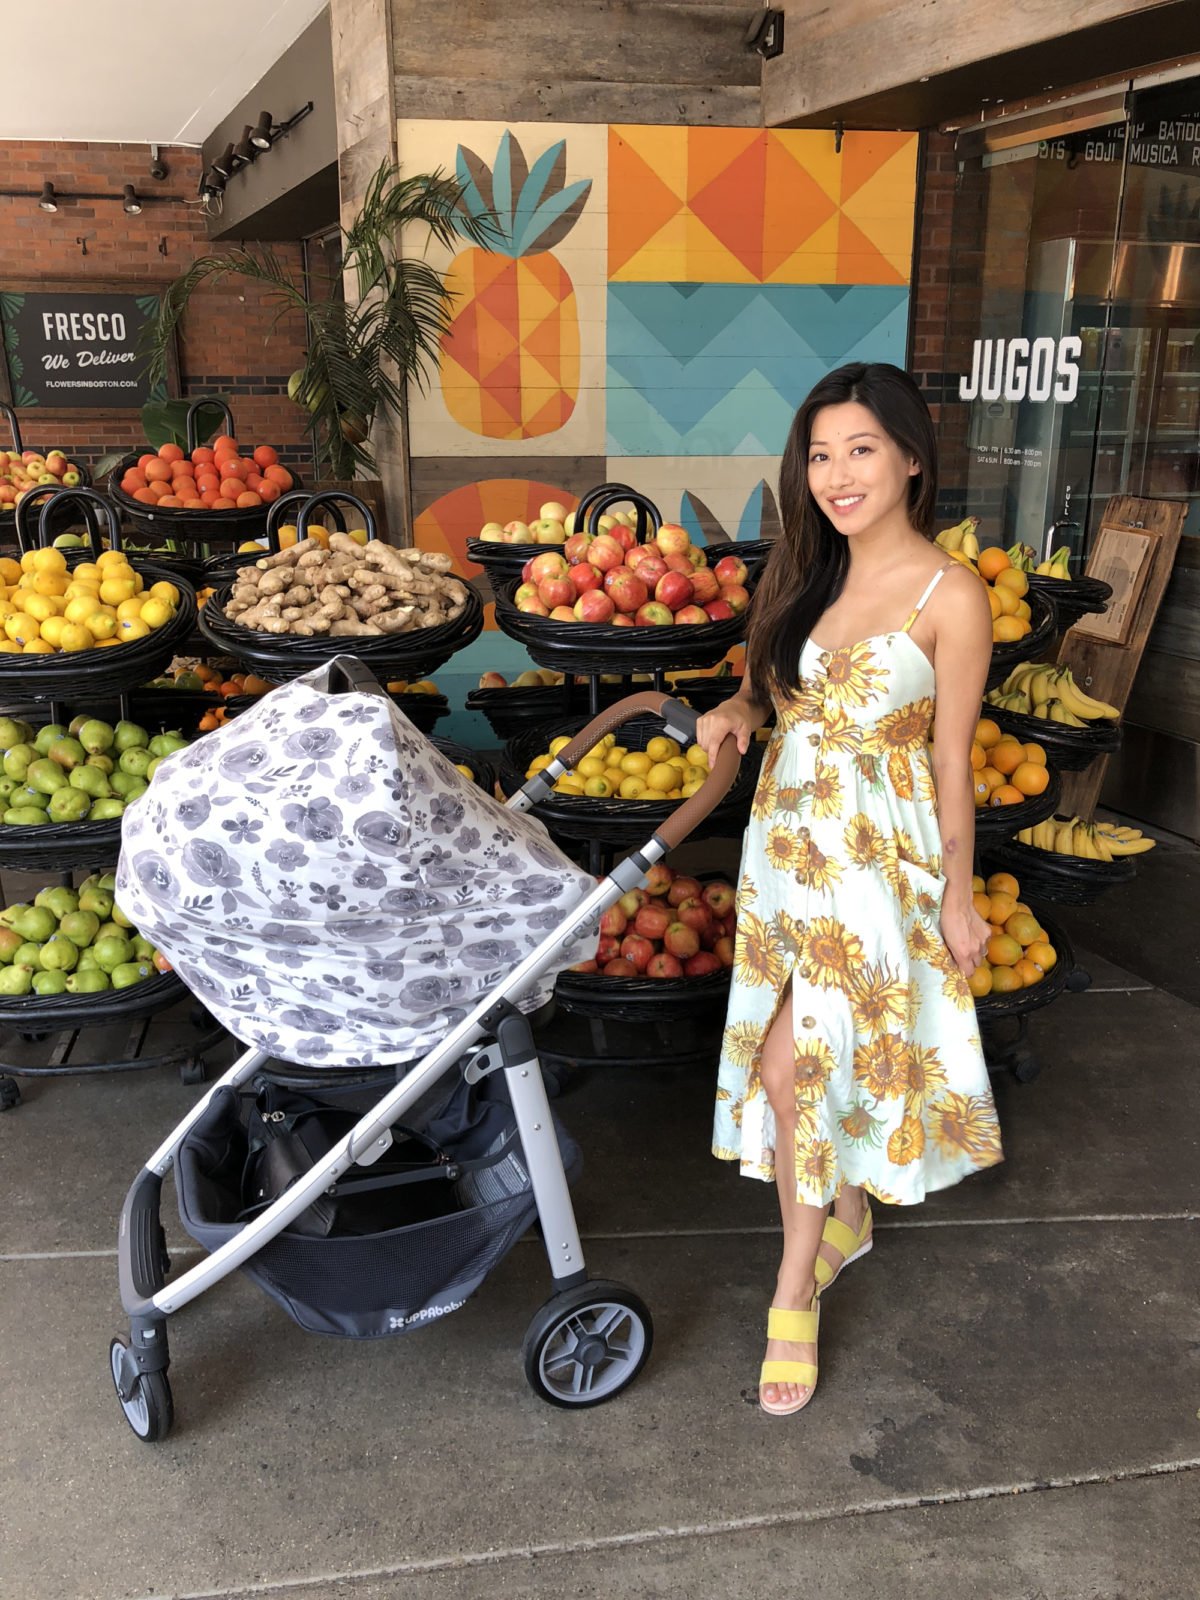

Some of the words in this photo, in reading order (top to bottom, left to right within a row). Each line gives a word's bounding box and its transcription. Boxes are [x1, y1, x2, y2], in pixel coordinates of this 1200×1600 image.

[1084, 141, 1115, 162] GOJI
[1130, 144, 1178, 165] MUSICA
[42, 312, 126, 341] FRESCO
[41, 354, 70, 370] We
[76, 350, 136, 367] Deliver
[959, 336, 1082, 403] JUGOS
[45, 380, 138, 388] FLOWERSINBOSTON.COM
[1064, 485, 1072, 516] PULL
[562, 905, 602, 948] CRUZ
